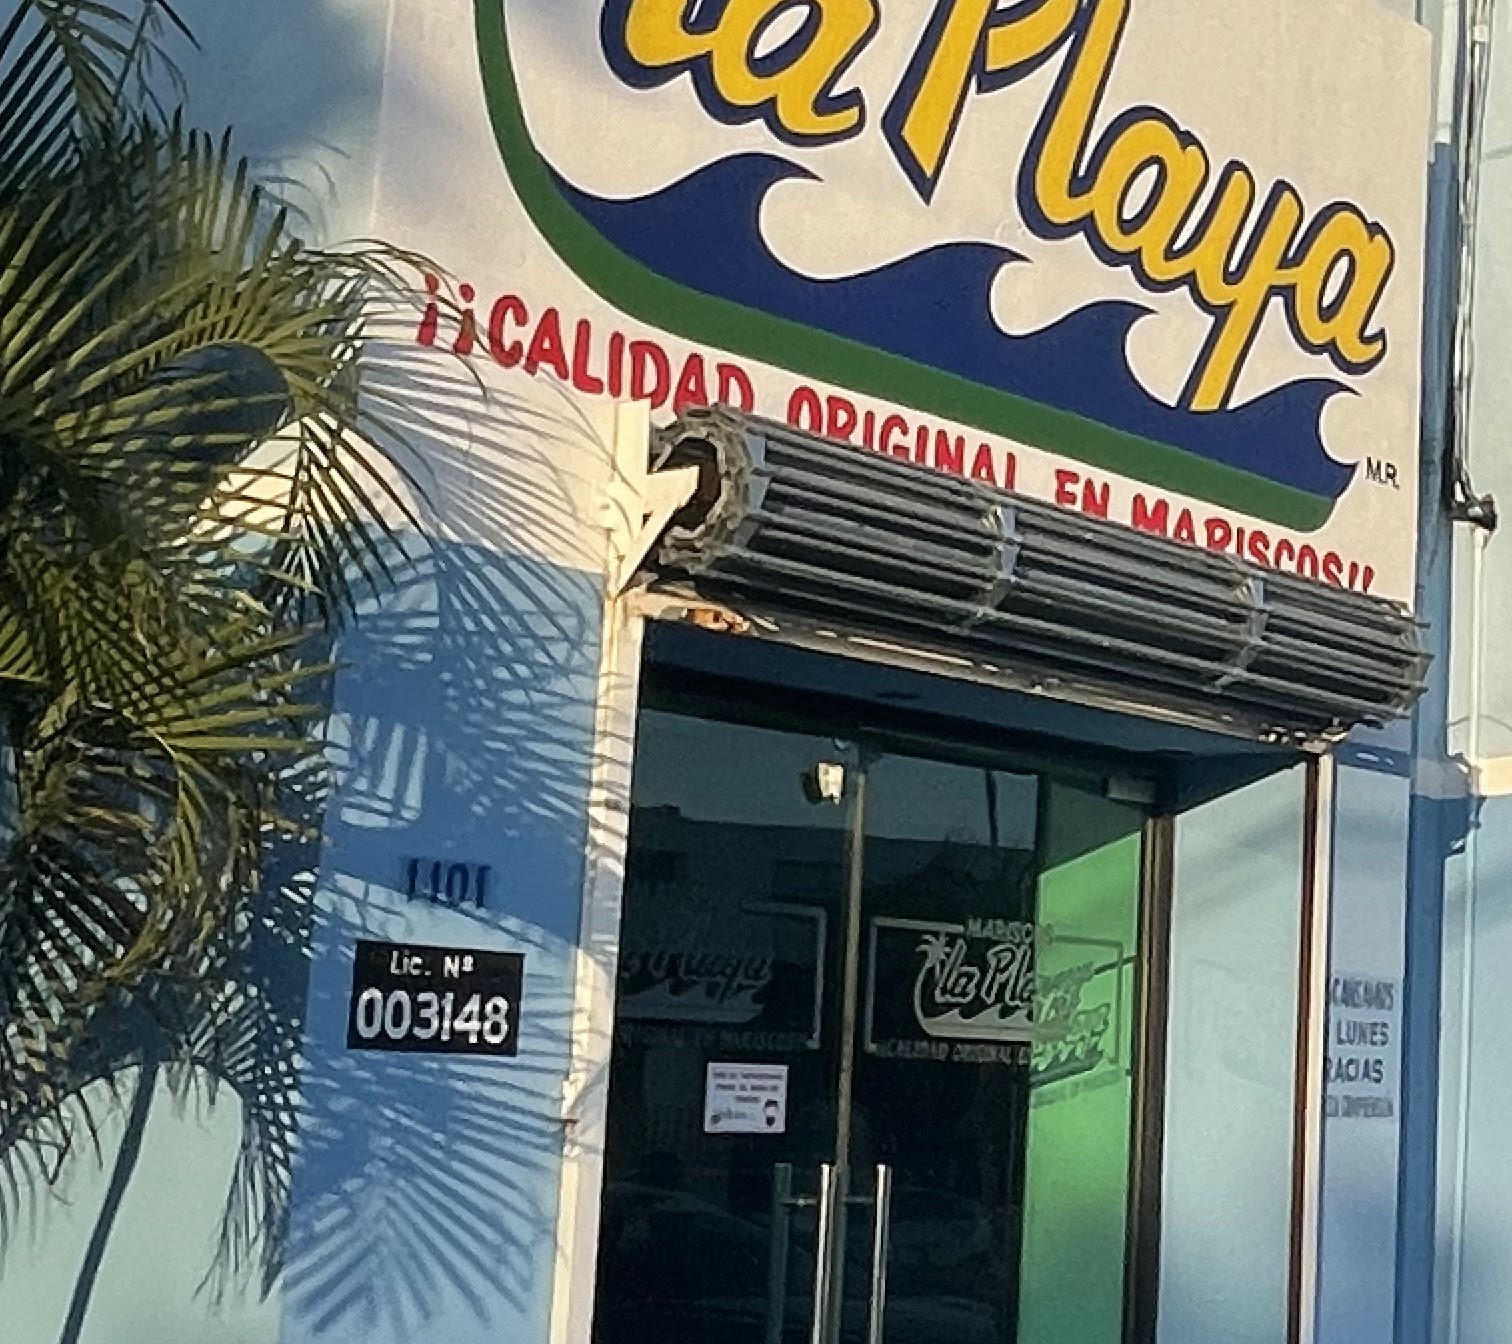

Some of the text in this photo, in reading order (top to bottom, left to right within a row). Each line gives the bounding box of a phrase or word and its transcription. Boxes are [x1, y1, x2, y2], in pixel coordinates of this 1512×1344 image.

[786, 384, 1016, 492] ORIGINAL
[1054, 468, 1110, 520] EN
[406, 858, 492, 908] 1101
[356, 986, 510, 1046] 003148
[1336, 1019, 1390, 1047] LUNES
